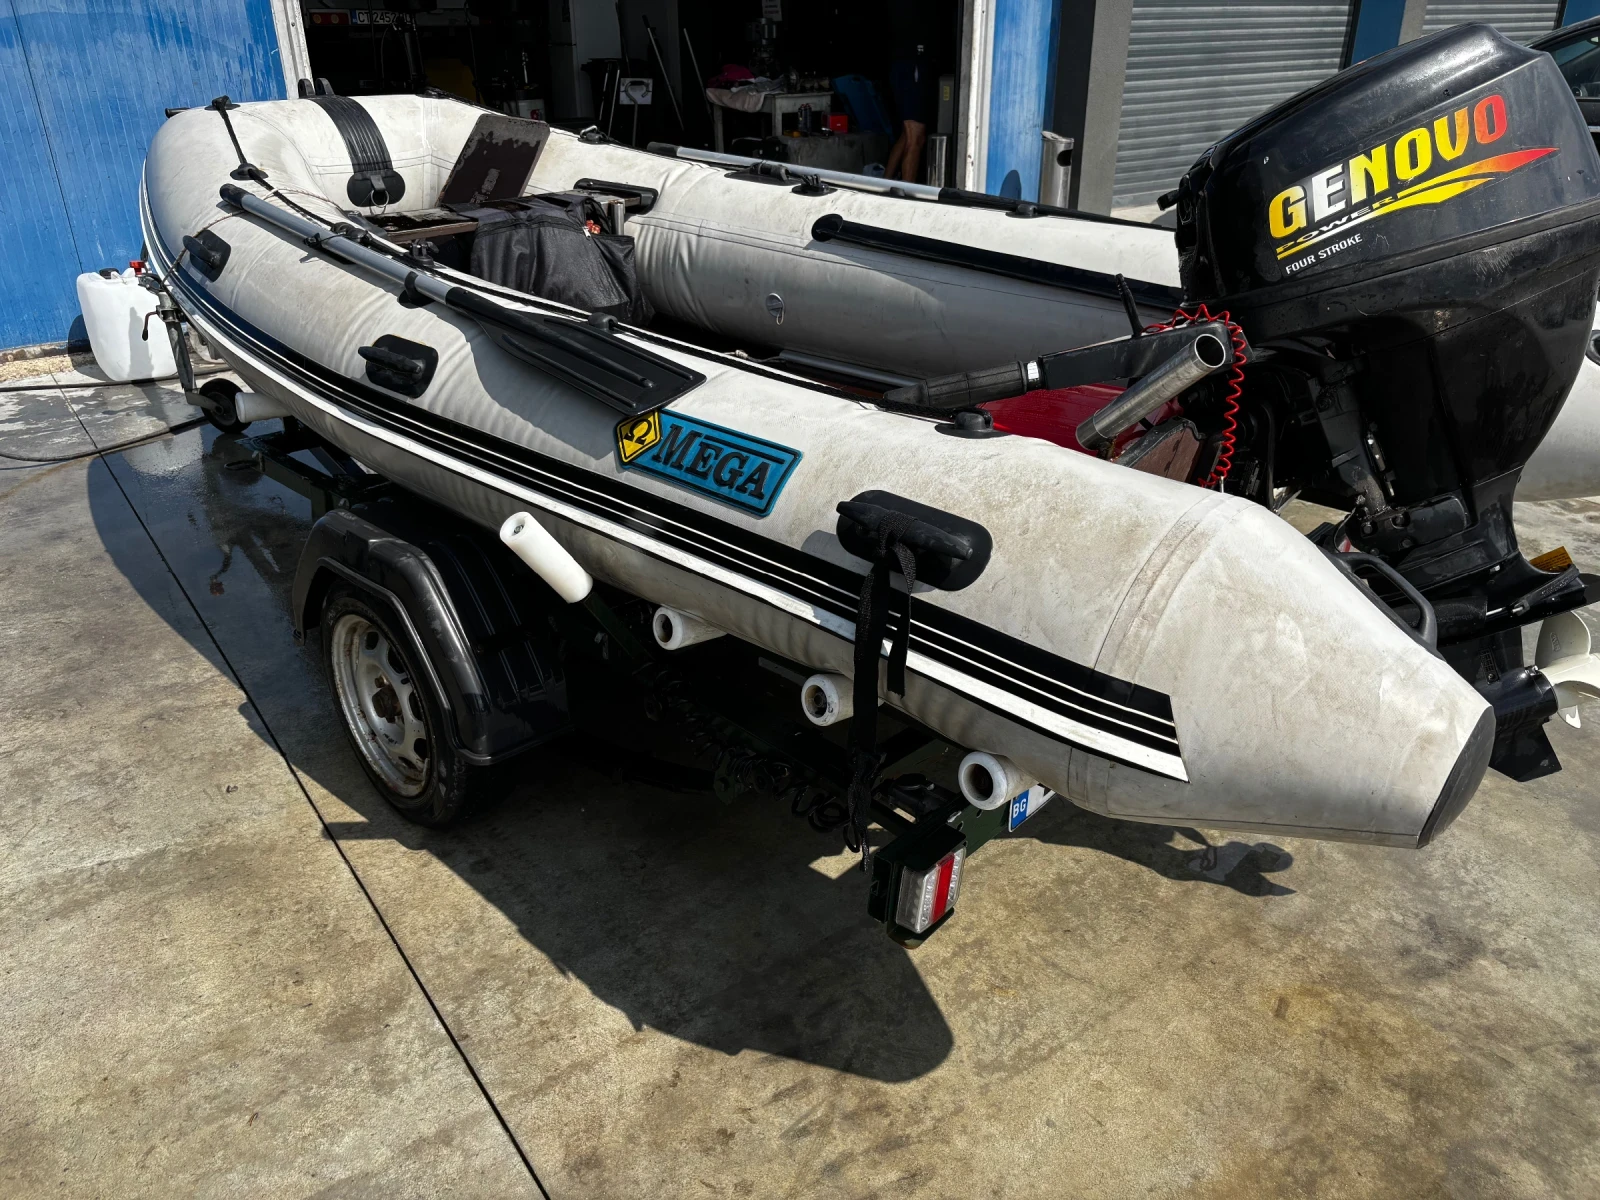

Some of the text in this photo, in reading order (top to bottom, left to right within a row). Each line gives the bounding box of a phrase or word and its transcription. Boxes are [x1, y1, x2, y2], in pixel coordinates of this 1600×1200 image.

[1268, 94, 1508, 238] GENOVO
[1275, 196, 1396, 254] POWER
[1285, 233, 1363, 275] FOUR STROKE
[652, 423, 771, 500] MEGA
[1012, 798, 1027, 819] BG
